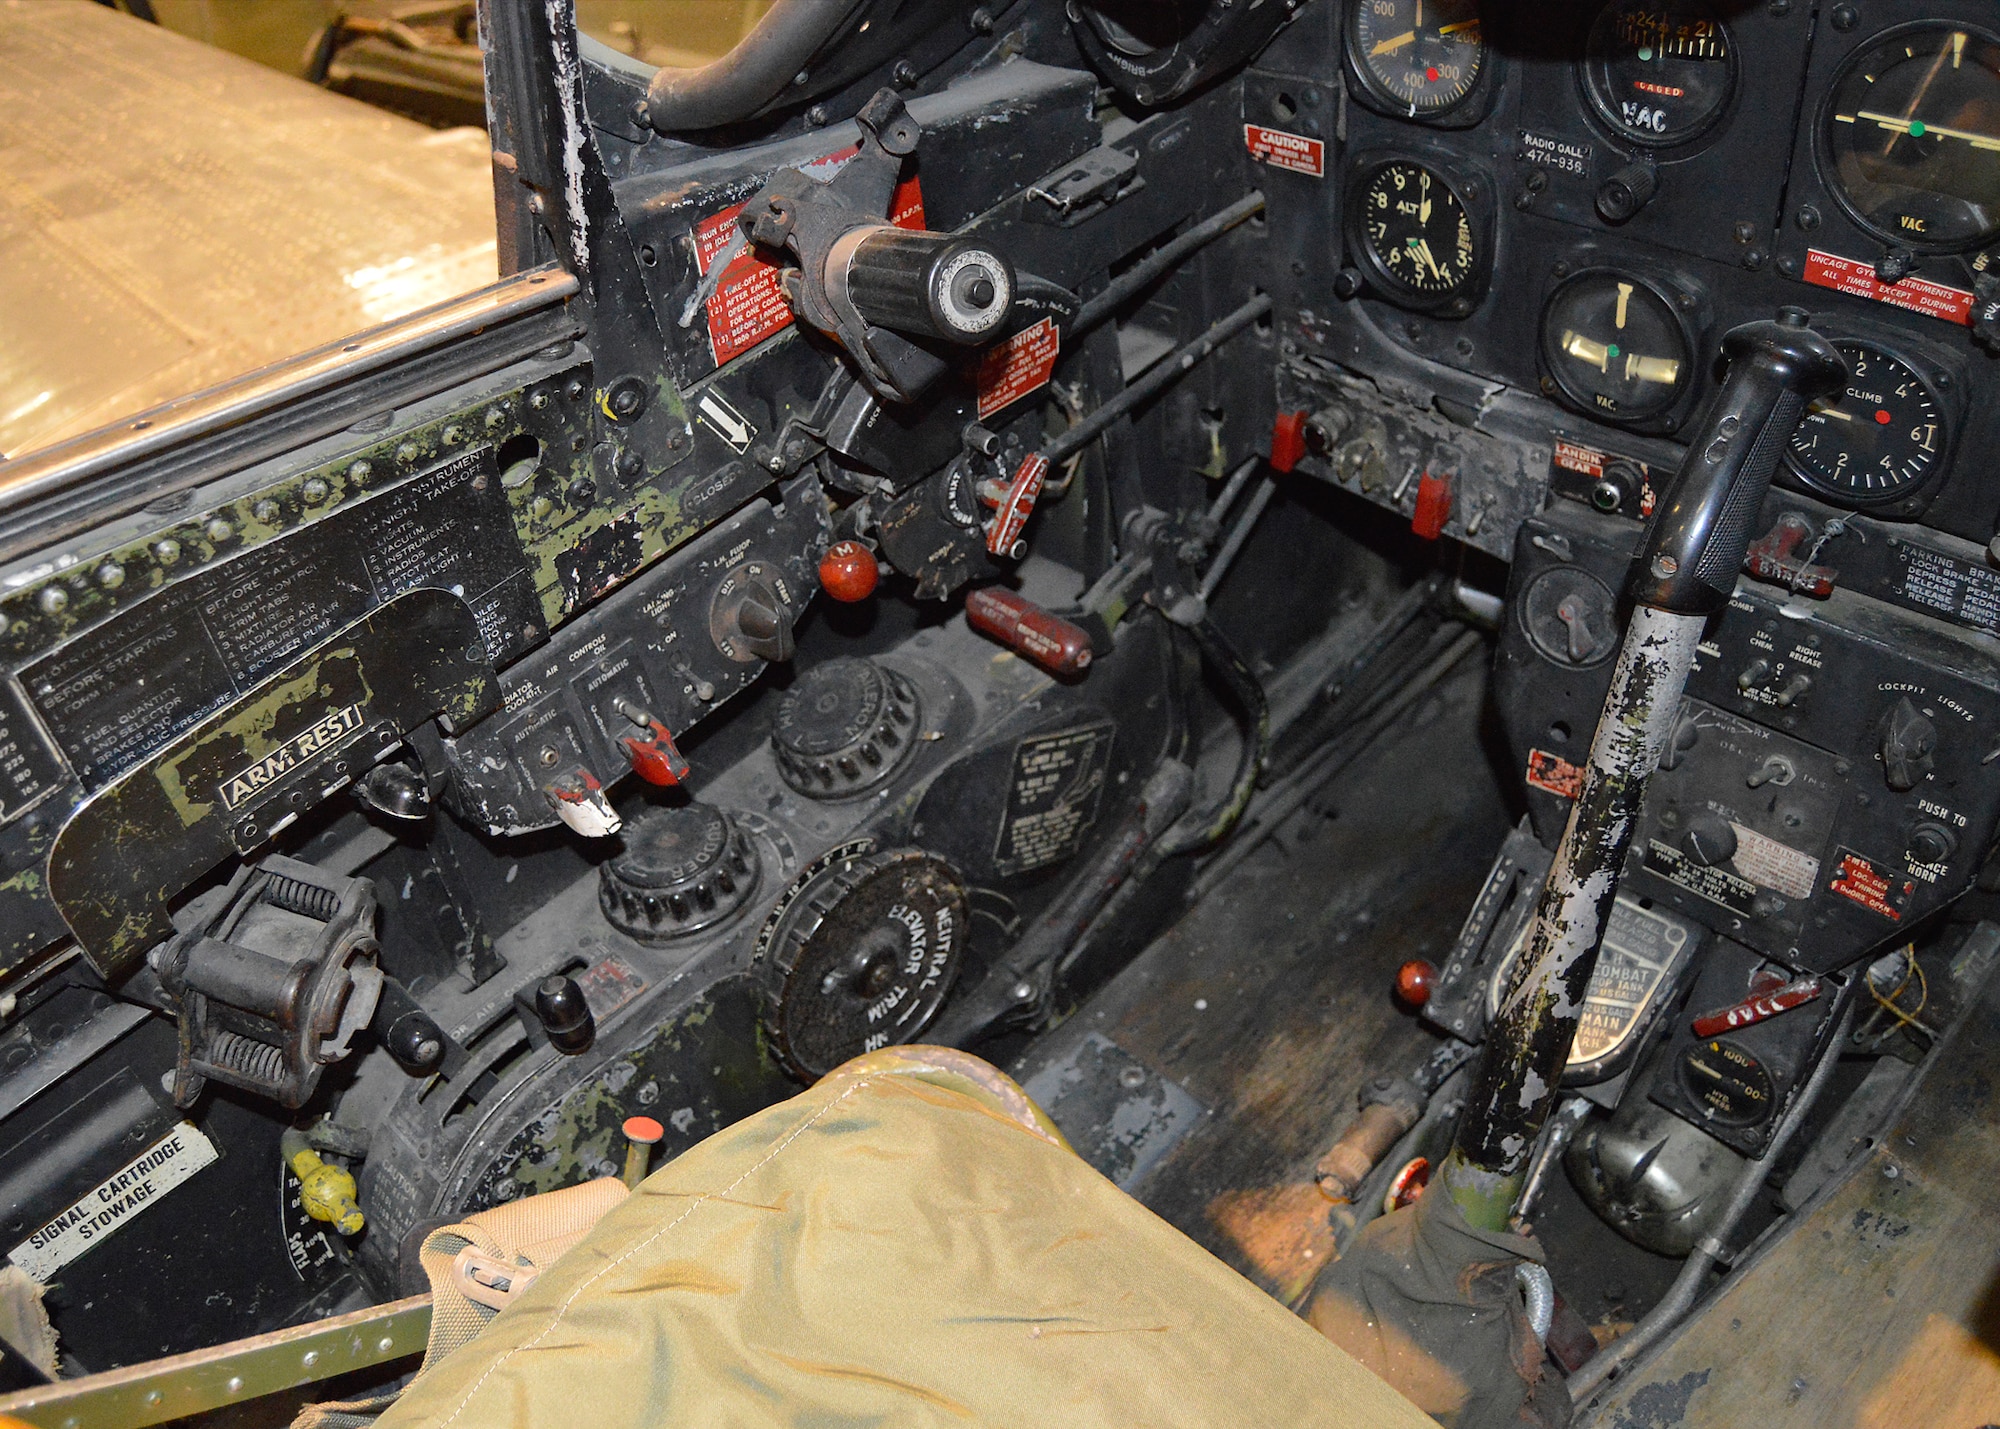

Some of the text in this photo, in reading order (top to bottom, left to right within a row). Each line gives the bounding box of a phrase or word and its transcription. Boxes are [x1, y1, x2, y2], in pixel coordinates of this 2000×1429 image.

[1374, 2, 1395, 17] 600
[1403, 71, 1425, 89] 400
[1437, 63, 1460, 80] 300
[1640, 82, 1682, 97] CAGED
[1622, 101, 1667, 133] VAC
[1260, 131, 1310, 153] CAUTION
[1524, 134, 1556, 151] RADIO
[1394, 174, 1406, 191] 9
[1377, 192, 1388, 209] 8
[1396, 200, 1420, 215] ALT
[1378, 222, 1387, 239] 7
[1901, 216, 1926, 232] VAC.
[1390, 247, 1401, 263] 6
[1456, 250, 1468, 267] 3
[1972, 252, 1990, 271] OFF
[1414, 263, 1425, 280] 5
[1440, 262, 1452, 279] 4
[1810, 255, 1876, 278] UNCAGE GYR
[726, 290, 748, 308] AFTER
[750, 278, 769, 294] EACH
[1822, 269, 1957, 313] ALL TIMES EXCEPT DURING
[1836, 283, 1938, 317] VIOLENT MANEUVERS
[730, 305, 760, 327] FOR ONE
[775, 311, 790, 323] FOR
[1856, 362, 1867, 377] 2
[1846, 387, 1883, 404] CLIMB
[1895, 384, 1907, 398] 4
[1597, 395, 1616, 411] VAC.
[1910, 427, 1921, 441] 6
[1560, 458, 1591, 474] GEAR
[1838, 453, 1848, 467] 2
[1880, 455, 1891, 469] 4
[425, 462, 484, 500] TAKE-OFF
[836, 542, 854, 557] M
[431, 553, 460, 575] LIGHT
[725, 552, 746, 569] LIGHT
[749, 565, 763, 575] ON
[1902, 545, 2000, 586] PARKING BRAK
[1907, 566, 1957, 588] DEPRESS
[1911, 558, 1979, 586] LOCK BRAKE
[775, 578, 792, 605] START
[1906, 574, 1955, 597] RELEASE
[206, 577, 262, 615] BEFORE
[1905, 582, 2000, 620] RELEASE HANDL
[223, 595, 262, 622] FLIGHT
[230, 592, 291, 633] TRIM TABS
[1907, 591, 1997, 628] RELEASE BRAKE
[239, 602, 316, 652] RADIATOR AIR
[486, 629, 501, 642] TO
[664, 630, 678, 645] ON
[1750, 637, 1775, 652] CHEM.
[249, 638, 302, 673] BOOSTER
[545, 633, 607, 679] AIR CONTROLS
[1789, 652, 1823, 669] RELEASE
[1795, 645, 1822, 659] RIGHT
[43, 627, 178, 709] BEFORE STARTING
[588, 658, 630, 693] AUTOMATIC
[172, 691, 232, 732] PRESSURE
[1878, 683, 1975, 722] COCKPIT LIGHTS
[84, 686, 178, 745] FUEL QUANTITY
[92, 697, 183, 755] AND SELECTOR
[96, 715, 171, 765] BRAKES AND
[4, 754, 25, 772] 225
[232, 706, 356, 805] ARM REST
[13, 768, 32, 784] 180
[20, 780, 39, 796] 165
[1918, 799, 1967, 828] PUSH TO
[671, 820, 722, 880] RUDDER
[1750, 836, 1801, 864] WARNING
[1907, 864, 1938, 884] HORN
[1853, 881, 1885, 900] FAIRING
[888, 904, 928, 975] ELEVATOR
[920, 906, 953, 990] NEUTRAL
[1592, 965, 1649, 982] COMBAT
[1617, 980, 1645, 993] TANK
[476, 1002, 496, 1020] AIR
[868, 985, 908, 1024] TRIM
[1577, 1024, 1606, 1038] TANK
[1581, 1013, 1620, 1030] MAIN
[29, 1136, 186, 1251] SIGNAL CARTRIDGE
[78, 1179, 157, 1240] STOWAGE
[288, 1231, 311, 1270] FLAPS
